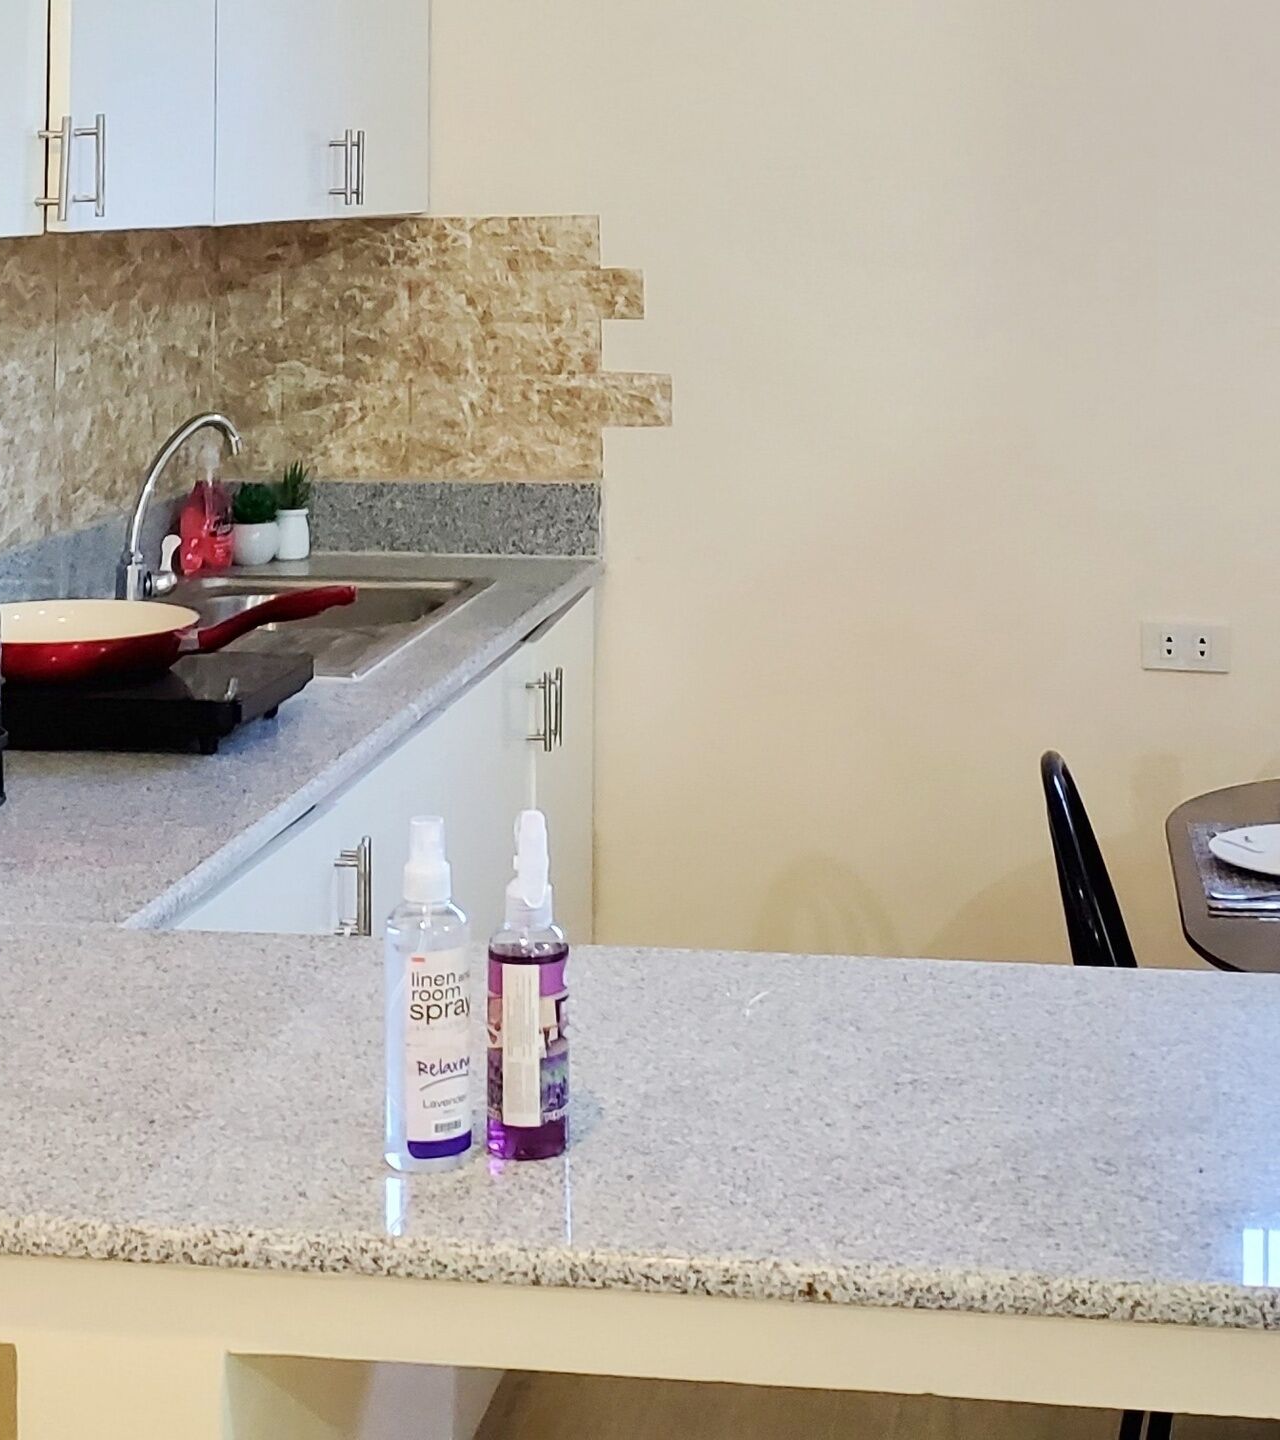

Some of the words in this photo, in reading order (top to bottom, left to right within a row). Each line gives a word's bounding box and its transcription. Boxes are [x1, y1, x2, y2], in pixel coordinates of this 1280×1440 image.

[411, 971, 456, 987] linen
[411, 985, 461, 1001] room
[410, 996, 471, 1025] spray
